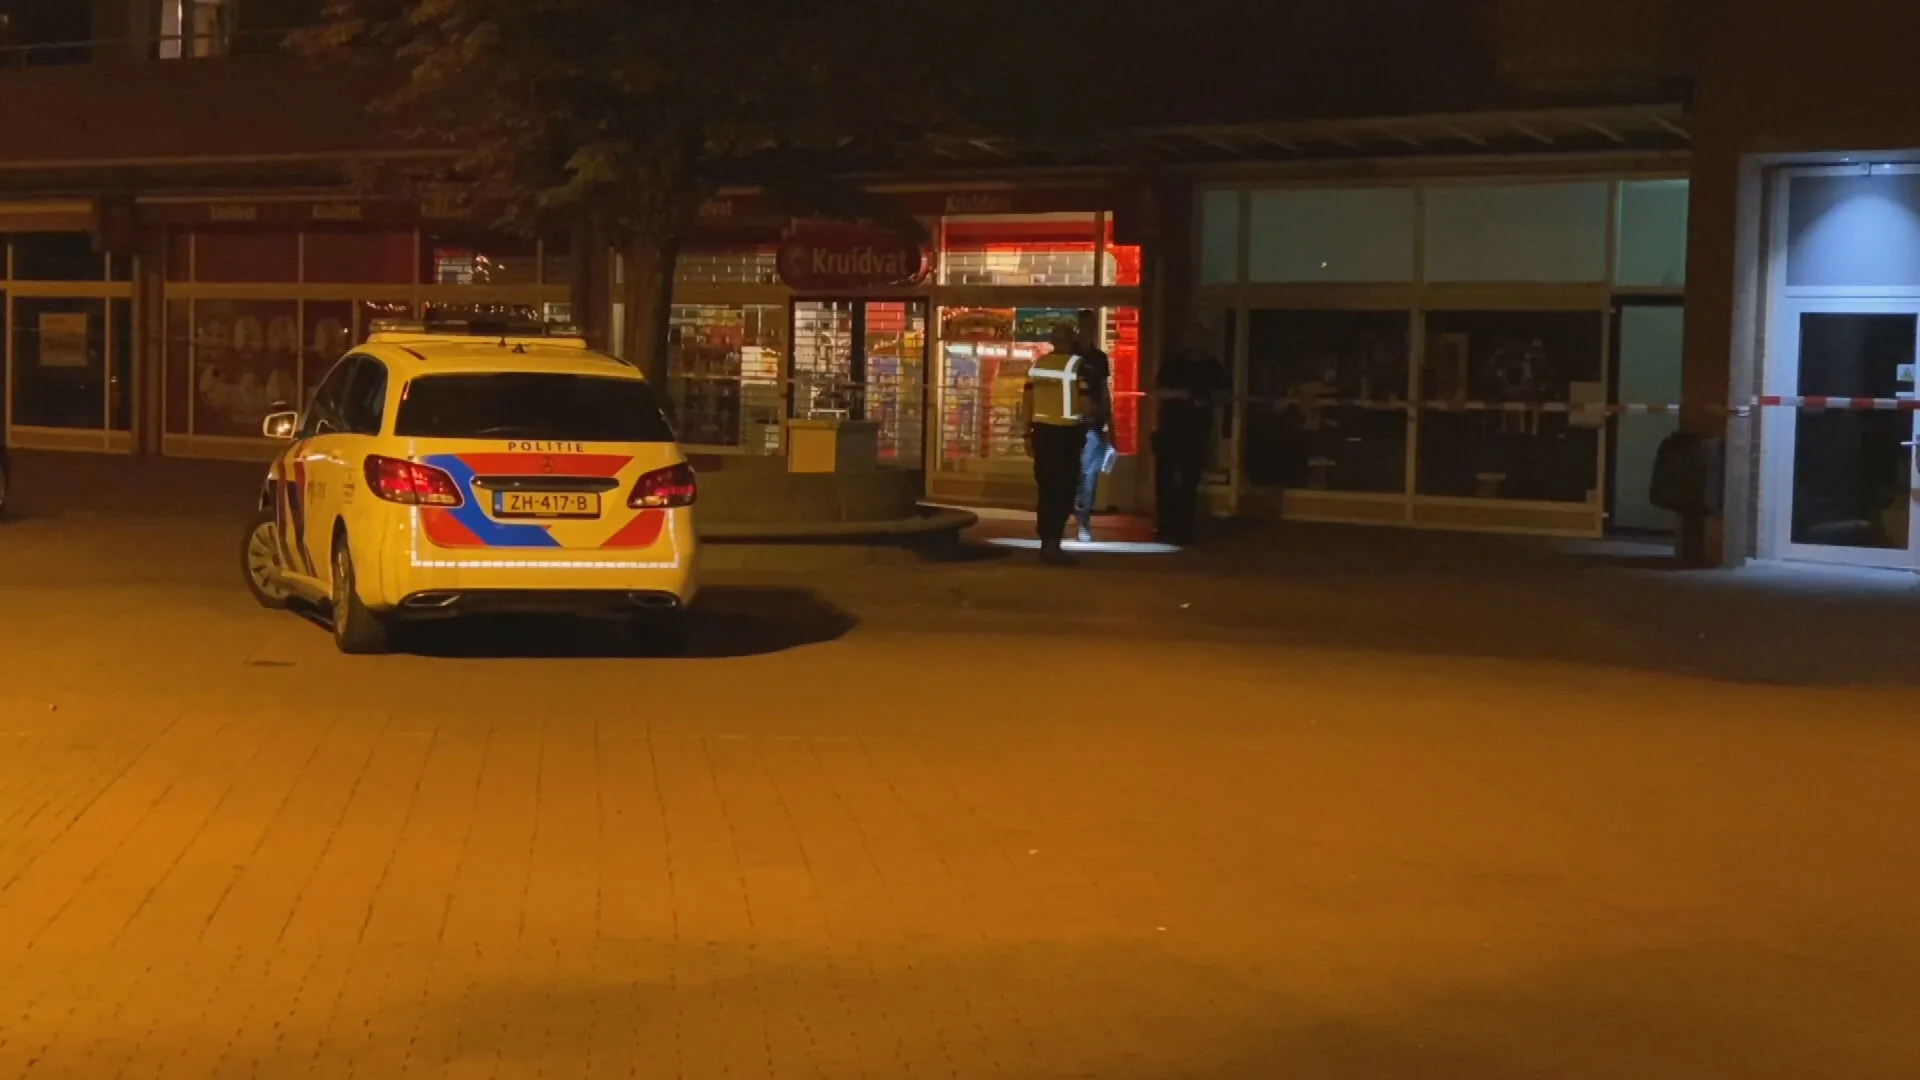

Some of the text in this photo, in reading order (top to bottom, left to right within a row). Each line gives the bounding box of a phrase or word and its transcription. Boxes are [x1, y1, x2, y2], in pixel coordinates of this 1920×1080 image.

[698, 199, 733, 217] dvat
[945, 193, 1011, 213] Kruidv
[811, 246, 909, 275] Kruidvat
[508, 442, 584, 453] POLITIE
[511, 495, 588, 511] ZH-417-B
